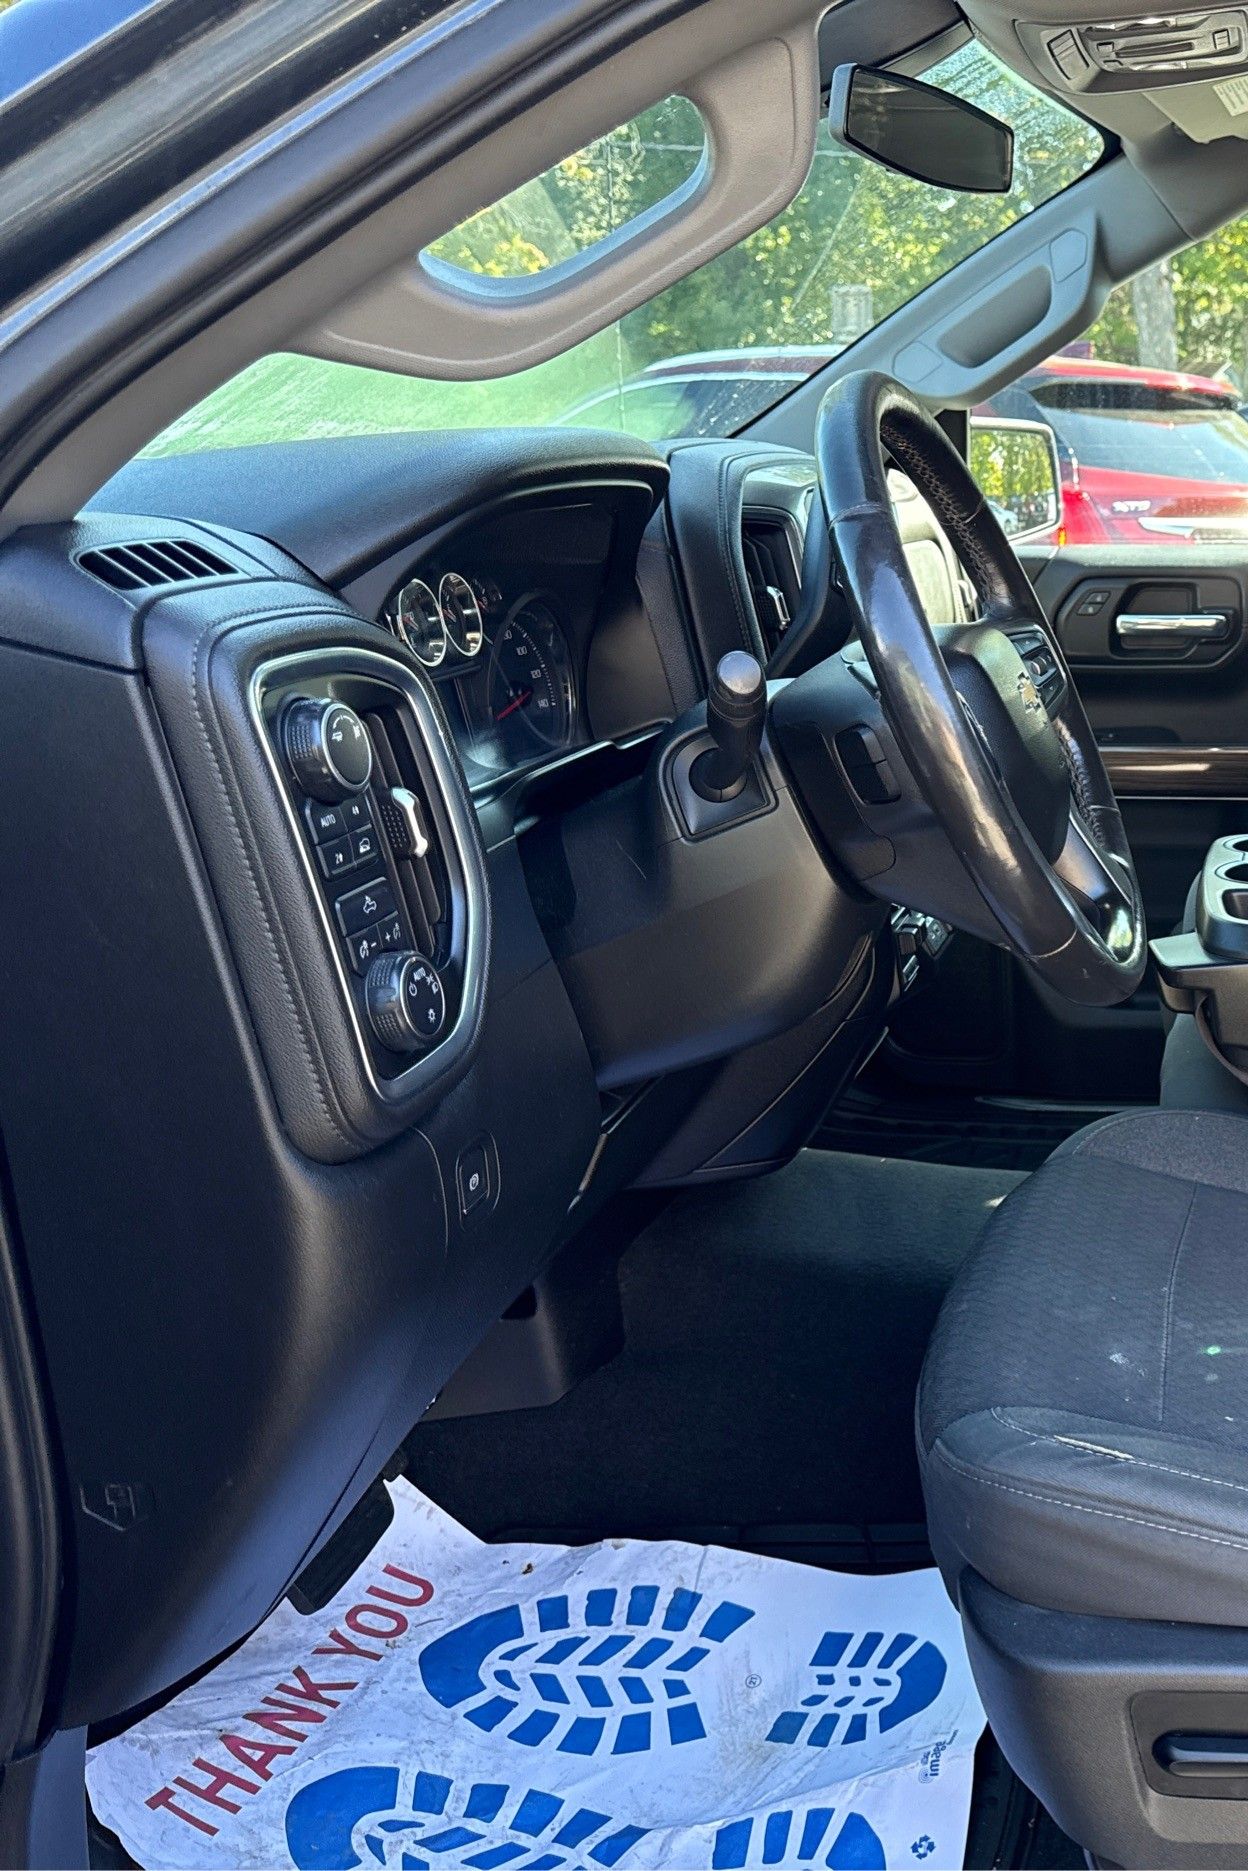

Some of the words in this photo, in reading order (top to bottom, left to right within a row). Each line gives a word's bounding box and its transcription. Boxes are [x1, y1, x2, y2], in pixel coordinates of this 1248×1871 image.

[320, 814, 336, 828] AUTO
[144, 1665, 359, 1837] THANK
[310, 1562, 435, 1662] YOU
